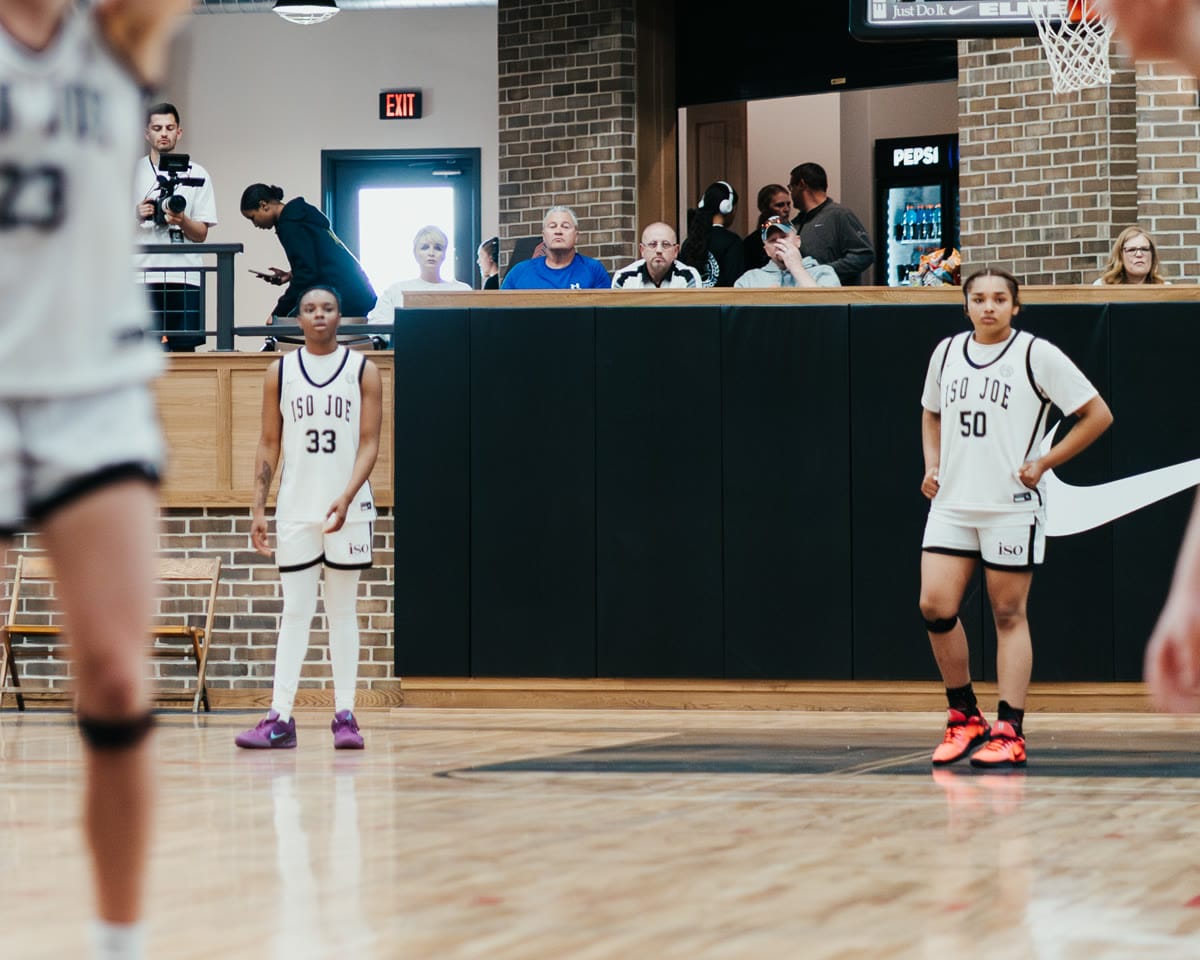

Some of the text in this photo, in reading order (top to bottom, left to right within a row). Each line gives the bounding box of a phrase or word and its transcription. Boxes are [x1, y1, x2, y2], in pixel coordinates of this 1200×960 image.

[892, 4, 947, 20] Just Do It.
[386, 93, 416, 117] EXIT
[893, 146, 939, 167] PEPSI
[945, 377, 1011, 410] ISO JOE
[291, 394, 352, 423] ISO JOE
[960, 411, 986, 437] 50
[305, 429, 336, 454] 33
[349, 543, 369, 554] iso
[999, 541, 1023, 556] iso
